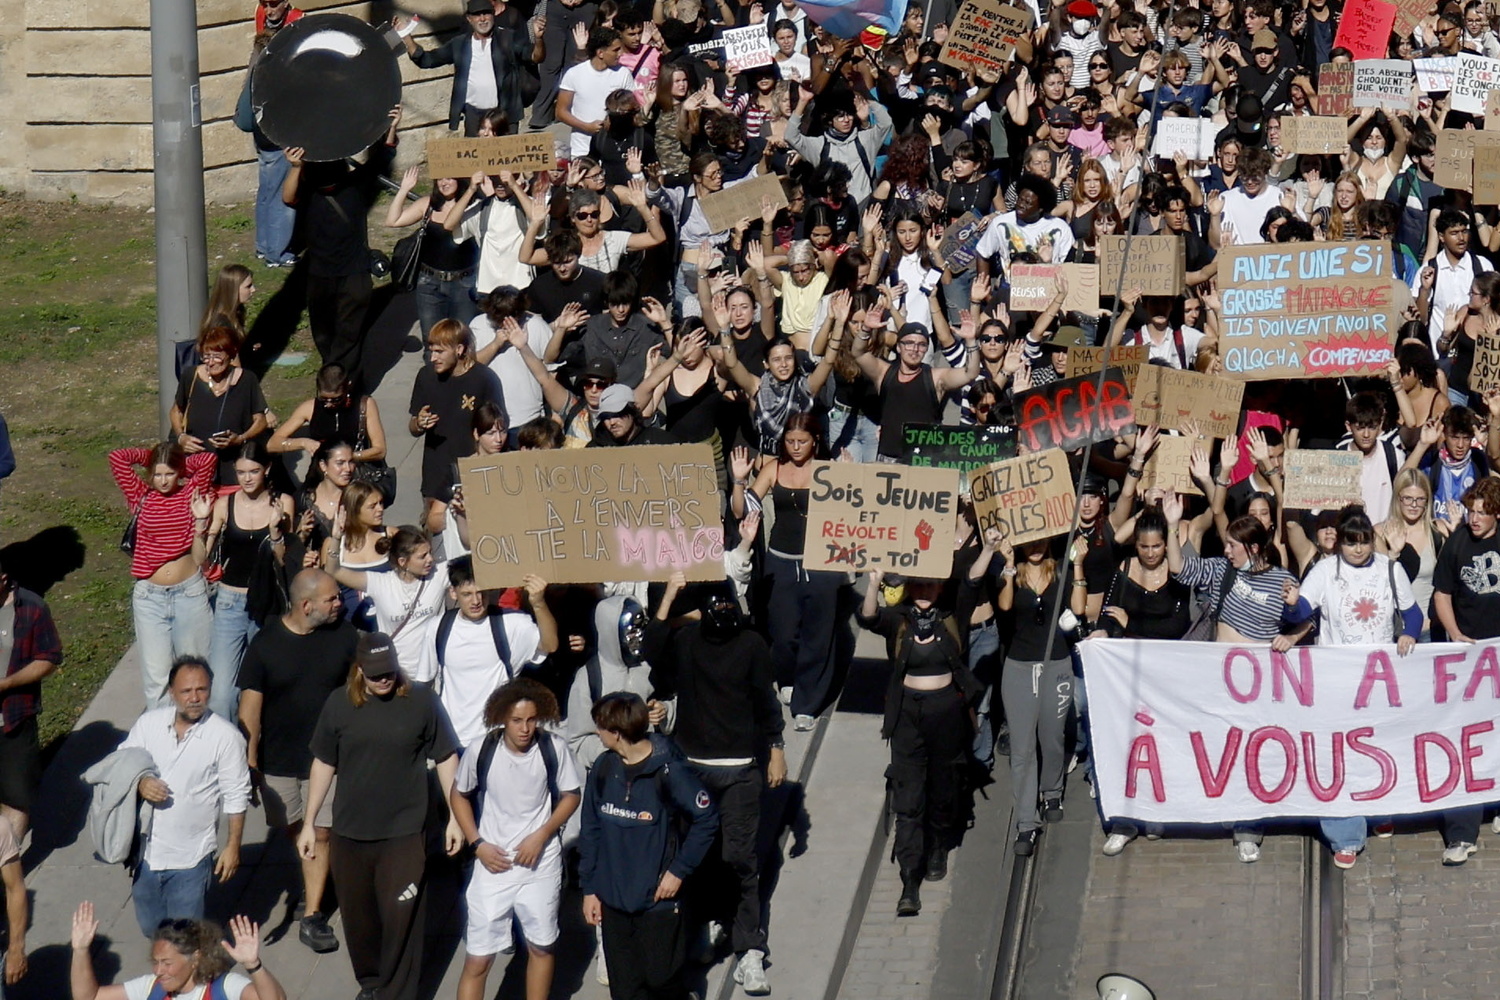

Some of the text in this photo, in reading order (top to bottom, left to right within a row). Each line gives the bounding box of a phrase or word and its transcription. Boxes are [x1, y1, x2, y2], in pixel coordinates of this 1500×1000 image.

[961, 13, 971, 21] LA
[965, 3, 979, 14] JE
[982, 9, 1016, 26] RENTRE
[1485, 2, 1497, 15] EN
[733, 39, 766, 55] POUR
[1358, 68, 1374, 76] MES
[1461, 58, 1488, 70] VOUS
[1357, 77, 1402, 87] CHOQUENT
[1457, 77, 1467, 86] DE
[1458, 68, 1473, 79] DES
[1476, 71, 1492, 82] CRS
[1356, 84, 1405, 94] QUE VOTRE
[1455, 87, 1470, 96] LES
[457, 149, 478, 158] BAC
[1233, 247, 1349, 283] AVEC UNE
[1222, 284, 1393, 315] GROSSE MATRAQUE
[1224, 318, 1254, 337] ILS
[1225, 342, 1392, 373] QLQCH À COMPENSER
[1020, 380, 1135, 450] ACAB
[949, 431, 976, 444] DES
[470, 462, 719, 497] TU NOUS LA METS
[972, 456, 1054, 503] GAZEZ LES
[876, 472, 951, 513] JEUNE
[573, 497, 704, 530] L'ENVERS
[859, 511, 880, 523] ET
[1010, 501, 1048, 536] LES
[821, 517, 898, 541] RÉVOLTE
[476, 527, 610, 565] ON TE LA
[1222, 646, 1315, 706] ON
[1353, 649, 1402, 710] A
[1124, 711, 1167, 803] À
[1189, 724, 1399, 805] VOUS
[1414, 720, 1496, 803] DE
[600, 803, 638, 820] ellesse
